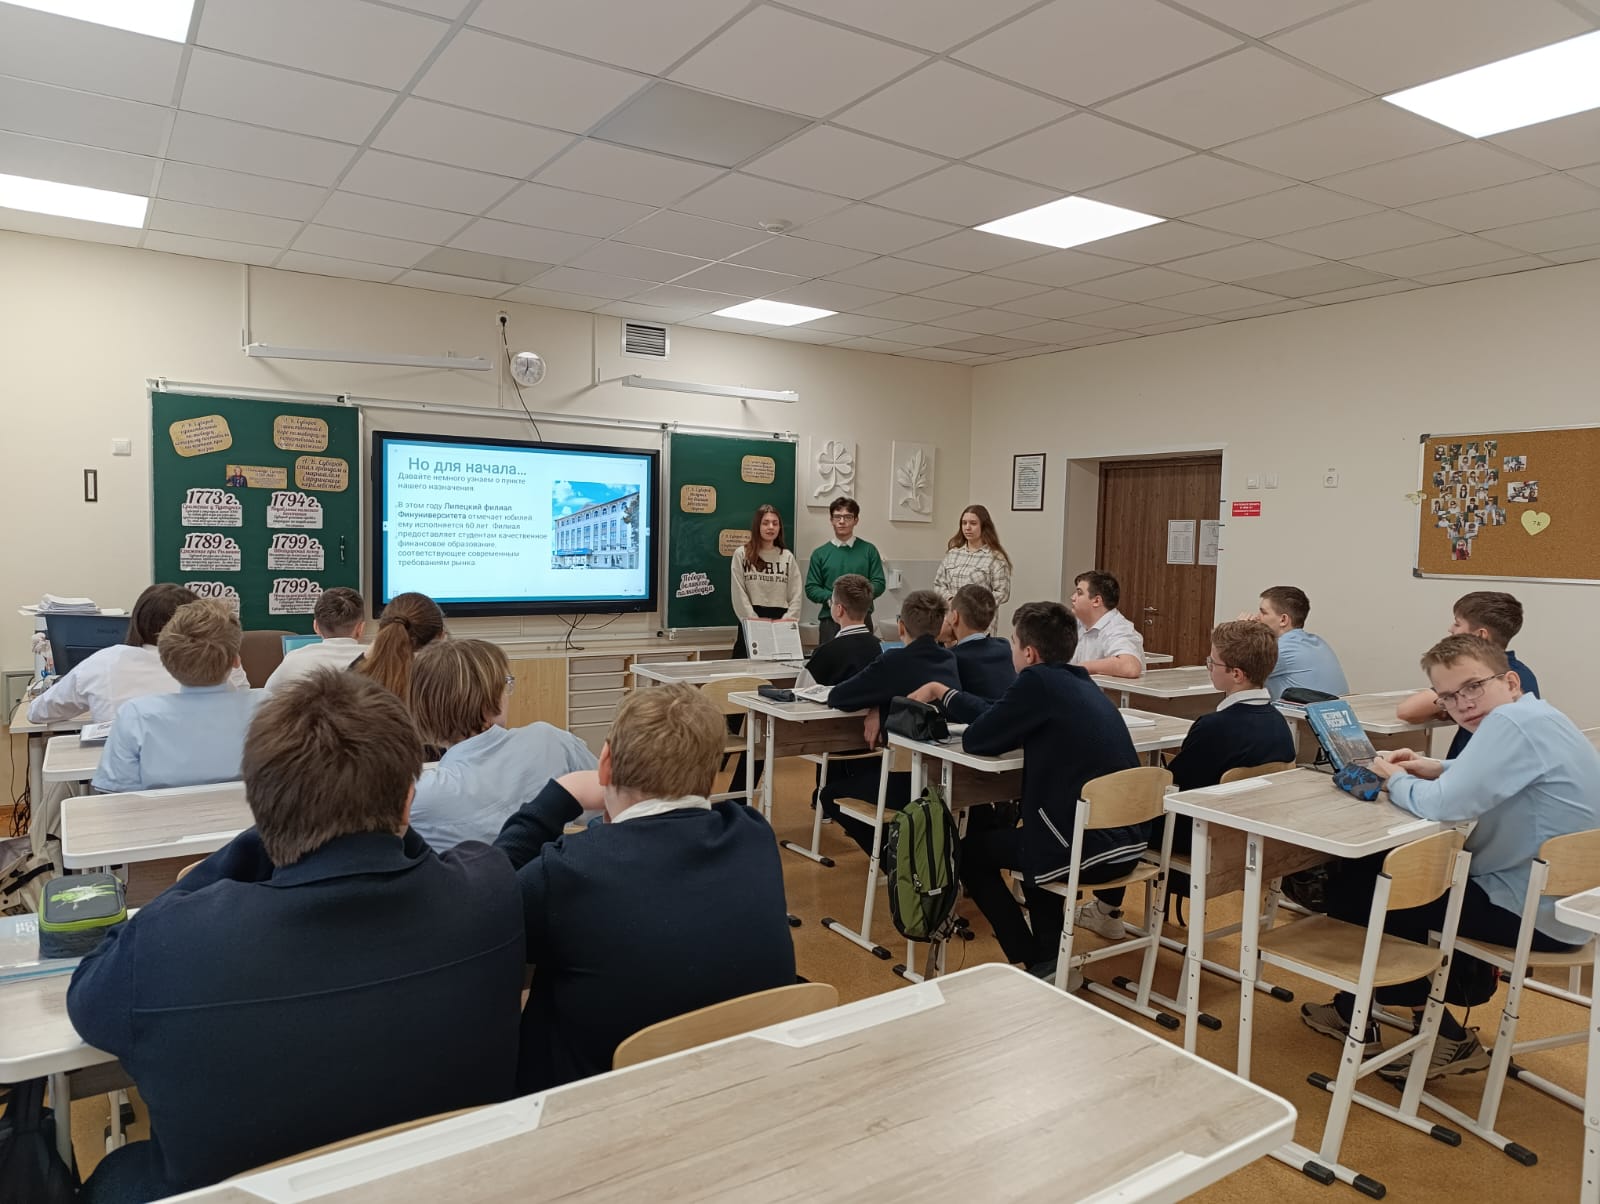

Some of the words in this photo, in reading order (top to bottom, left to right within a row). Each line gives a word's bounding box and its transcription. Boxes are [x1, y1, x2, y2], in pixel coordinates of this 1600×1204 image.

[408, 457, 430, 471] Но
[433, 461, 461, 474] для
[465, 463, 527, 476] начала...
[398, 472, 432, 481] Давайте
[433, 474, 466, 482] немного
[467, 476, 494, 484] узнаем
[502, 478, 526, 486] пункте
[188, 490, 223, 505] 1773
[225, 495, 238, 505] г.
[273, 493, 306, 507] 1794
[307, 498, 319, 508] г.
[426, 503, 443, 511] году
[444, 502, 482, 511] Липецкий
[484, 503, 513, 512] филиал
[467, 513, 503, 521] отмечает
[186, 534, 222, 549] 1789
[224, 539, 237, 549] г.
[398, 531, 456, 540] предоставляет
[458, 532, 497, 540] студентам
[273, 535, 308, 549] 1799
[309, 540, 321, 549] г.
[398, 540, 446, 548] финансовое
[398, 550, 466, 558] соответствующее
[467, 551, 520, 559] современным
[398, 559, 450, 568] требованиям
[224, 588, 237, 598] г.
[274, 580, 308, 594] 1799
[310, 583, 322, 593] г.
